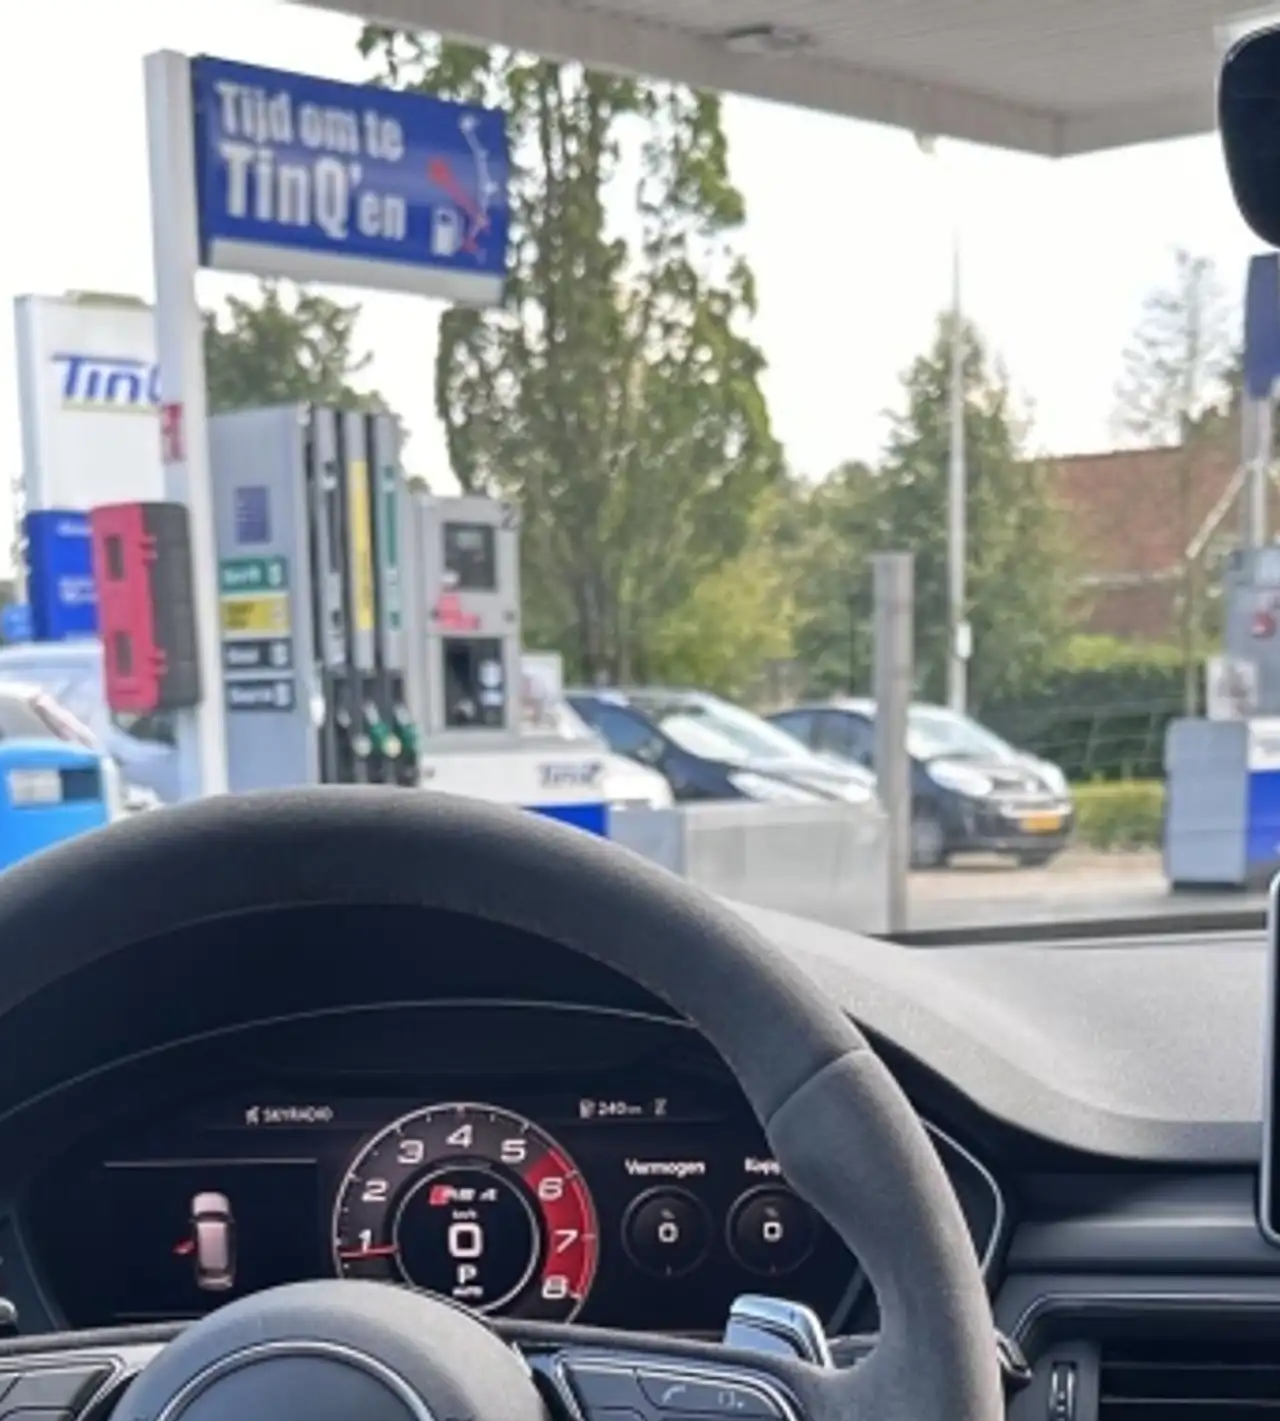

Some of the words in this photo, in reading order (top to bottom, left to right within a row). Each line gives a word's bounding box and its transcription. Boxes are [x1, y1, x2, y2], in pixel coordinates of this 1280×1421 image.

[214, 80, 293, 143] Tijd
[299, 102, 359, 154] om
[365, 110, 405, 161] te
[219, 141, 406, 240] TinQ'en
[446, 1124, 473, 1148] 4
[397, 1140, 424, 1164] 3
[500, 1139, 527, 1161] 5
[624, 1158, 706, 1178] Vermogen
[362, 1180, 389, 1202] 2
[538, 1177, 564, 1200] 6
[359, 1229, 372, 1254] 1
[448, 1222, 483, 1258] 0
[553, 1229, 579, 1253] 7
[657, 1222, 679, 1243] 0
[763, 1221, 784, 1242] 0
[457, 1263, 477, 1285] P
[542, 1274, 568, 1299] 8
